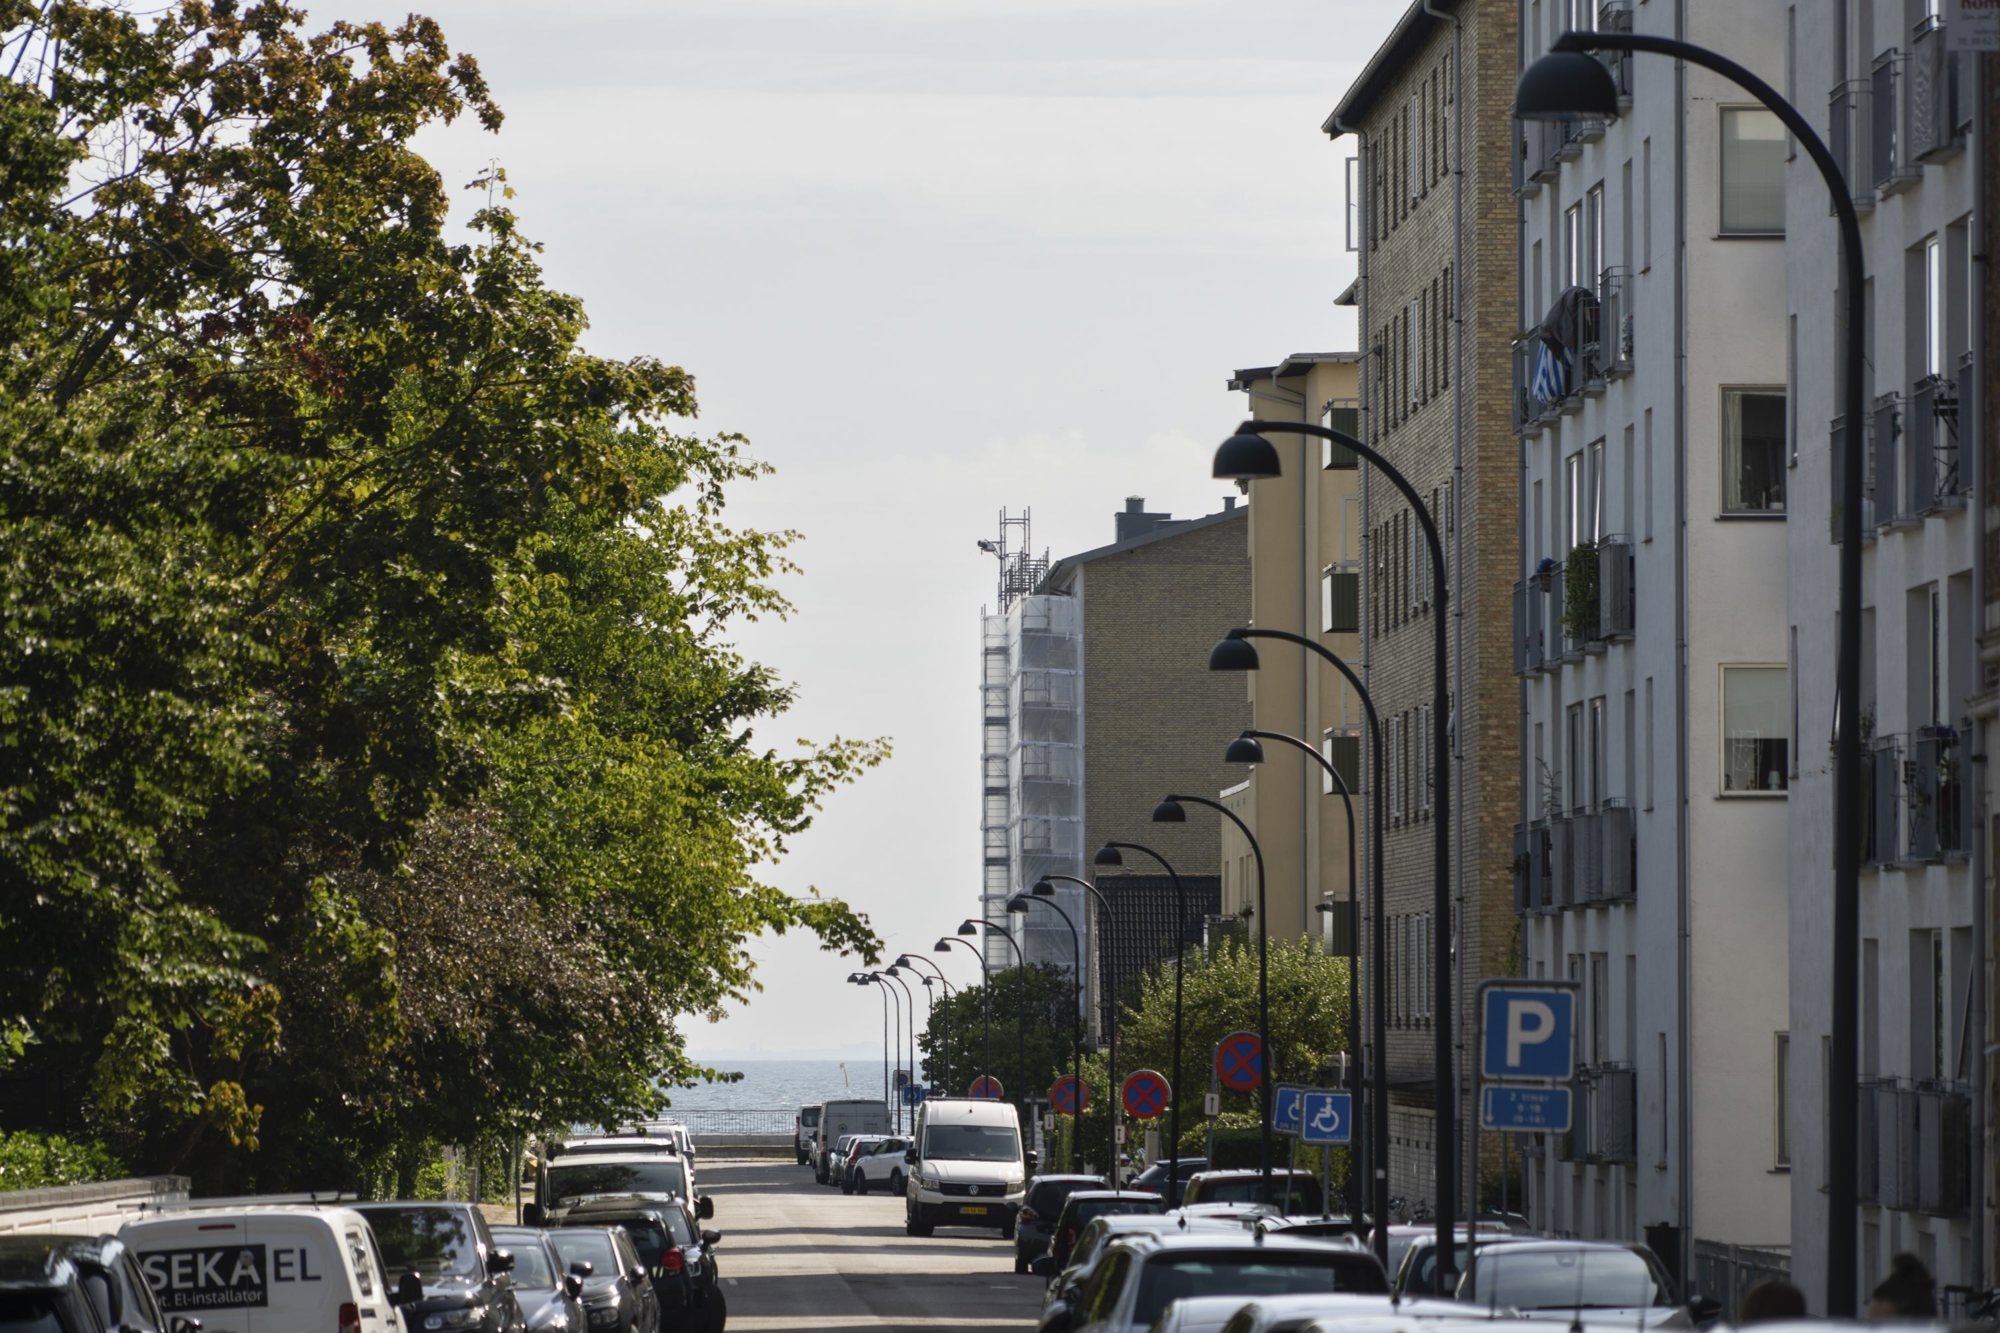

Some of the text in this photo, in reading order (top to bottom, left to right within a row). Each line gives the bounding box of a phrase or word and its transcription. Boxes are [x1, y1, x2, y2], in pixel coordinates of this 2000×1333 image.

[1506, 999, 1556, 1068] P
[142, 1248, 322, 1292] SEKA EL
[174, 1289, 263, 1307] El-installatør
